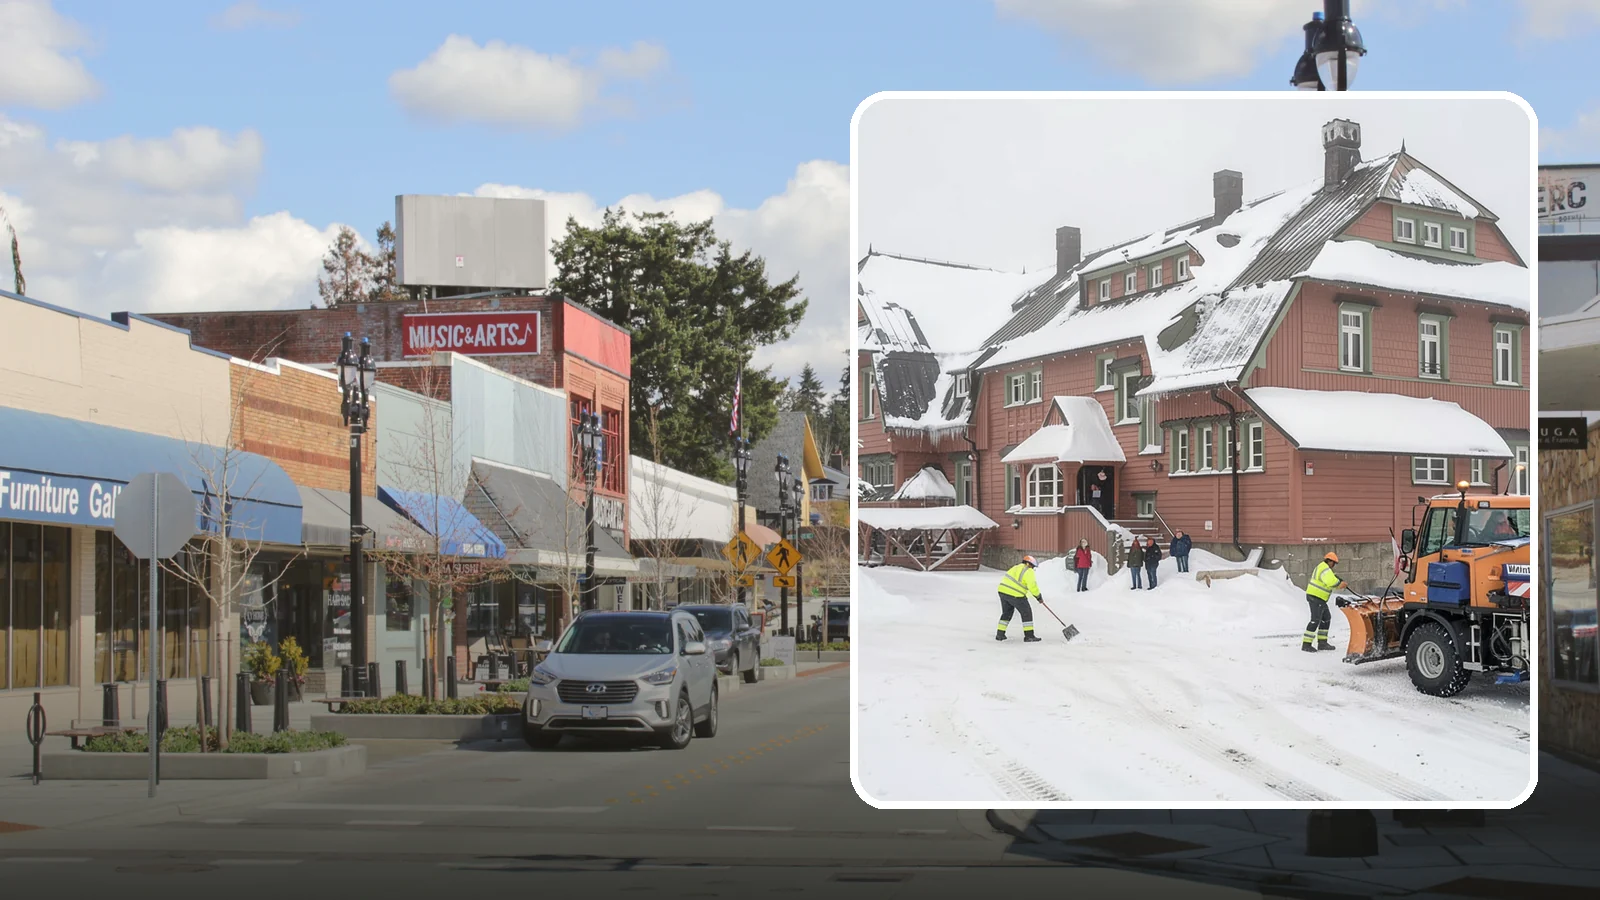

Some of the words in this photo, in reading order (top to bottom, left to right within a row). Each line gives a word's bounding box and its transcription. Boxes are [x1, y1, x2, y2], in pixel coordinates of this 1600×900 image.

[1540, 427, 1577, 437] UGA
[0, 471, 79, 515] Furniture
[89, 482, 122, 519] Gal
